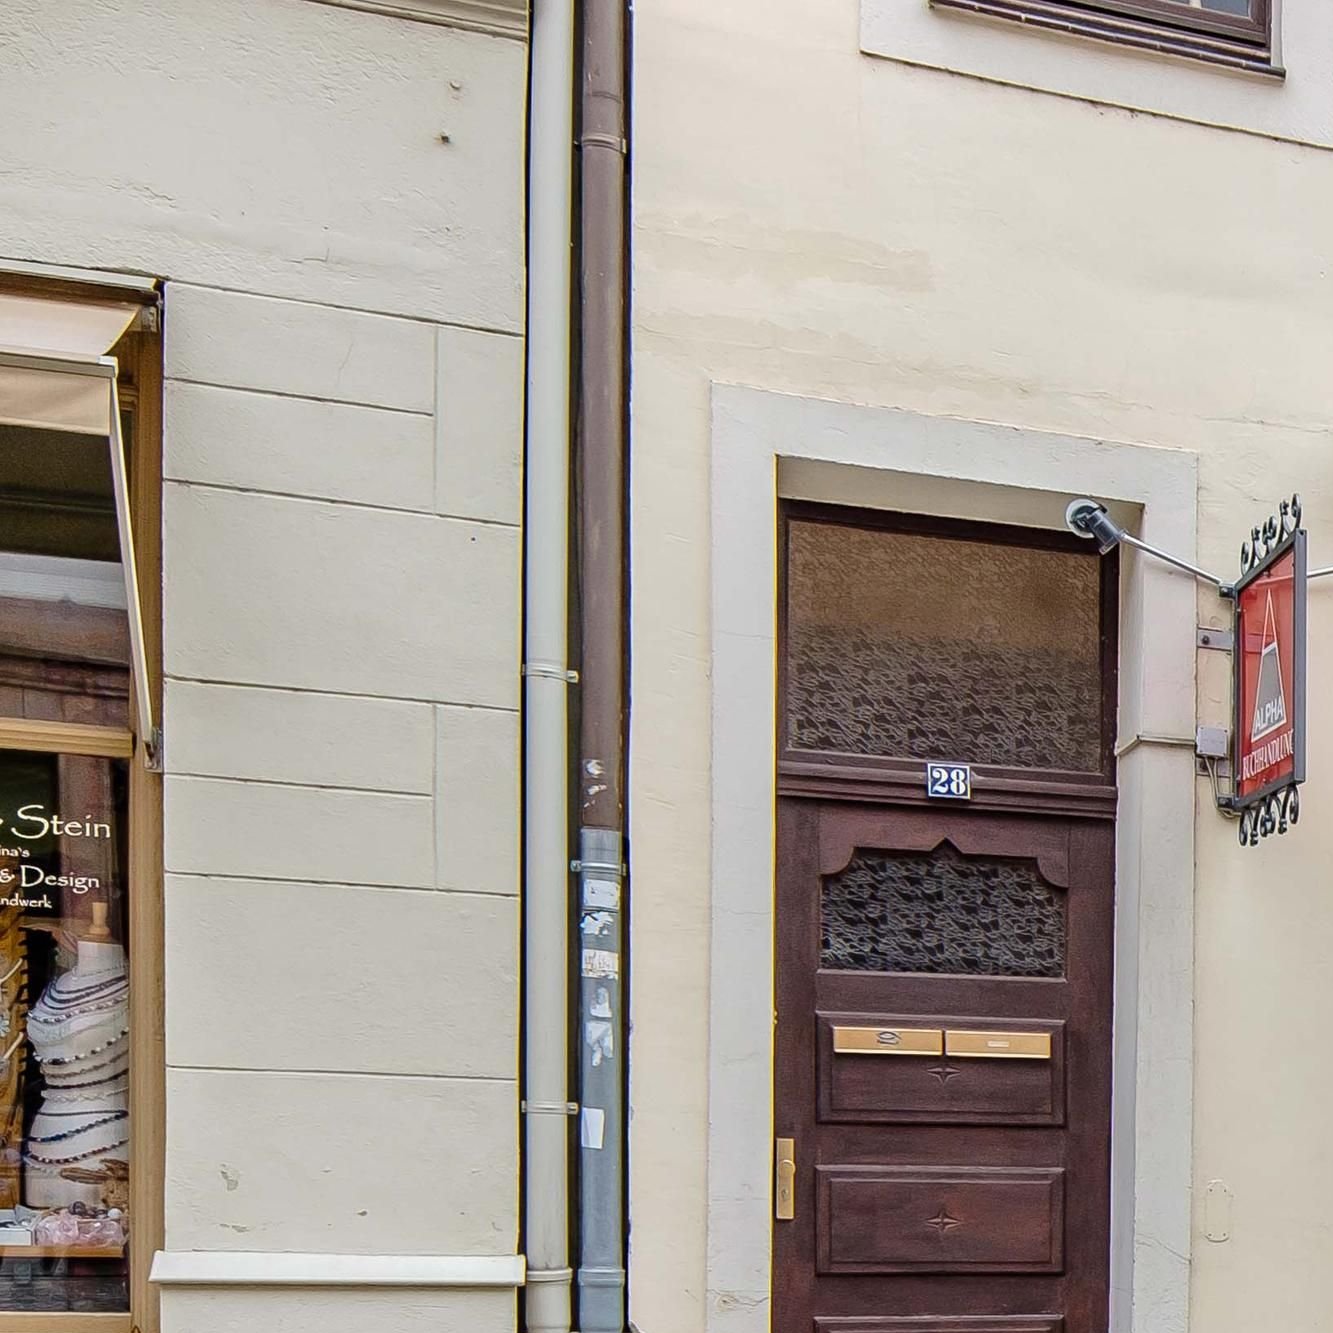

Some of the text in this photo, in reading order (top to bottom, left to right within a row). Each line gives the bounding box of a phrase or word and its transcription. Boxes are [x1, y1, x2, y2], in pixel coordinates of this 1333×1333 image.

[1254, 695, 1284, 734] ALPHA
[932, 767, 966, 795] 28
[11, 804, 111, 839] Stein
[20, 864, 100, 894] Design
